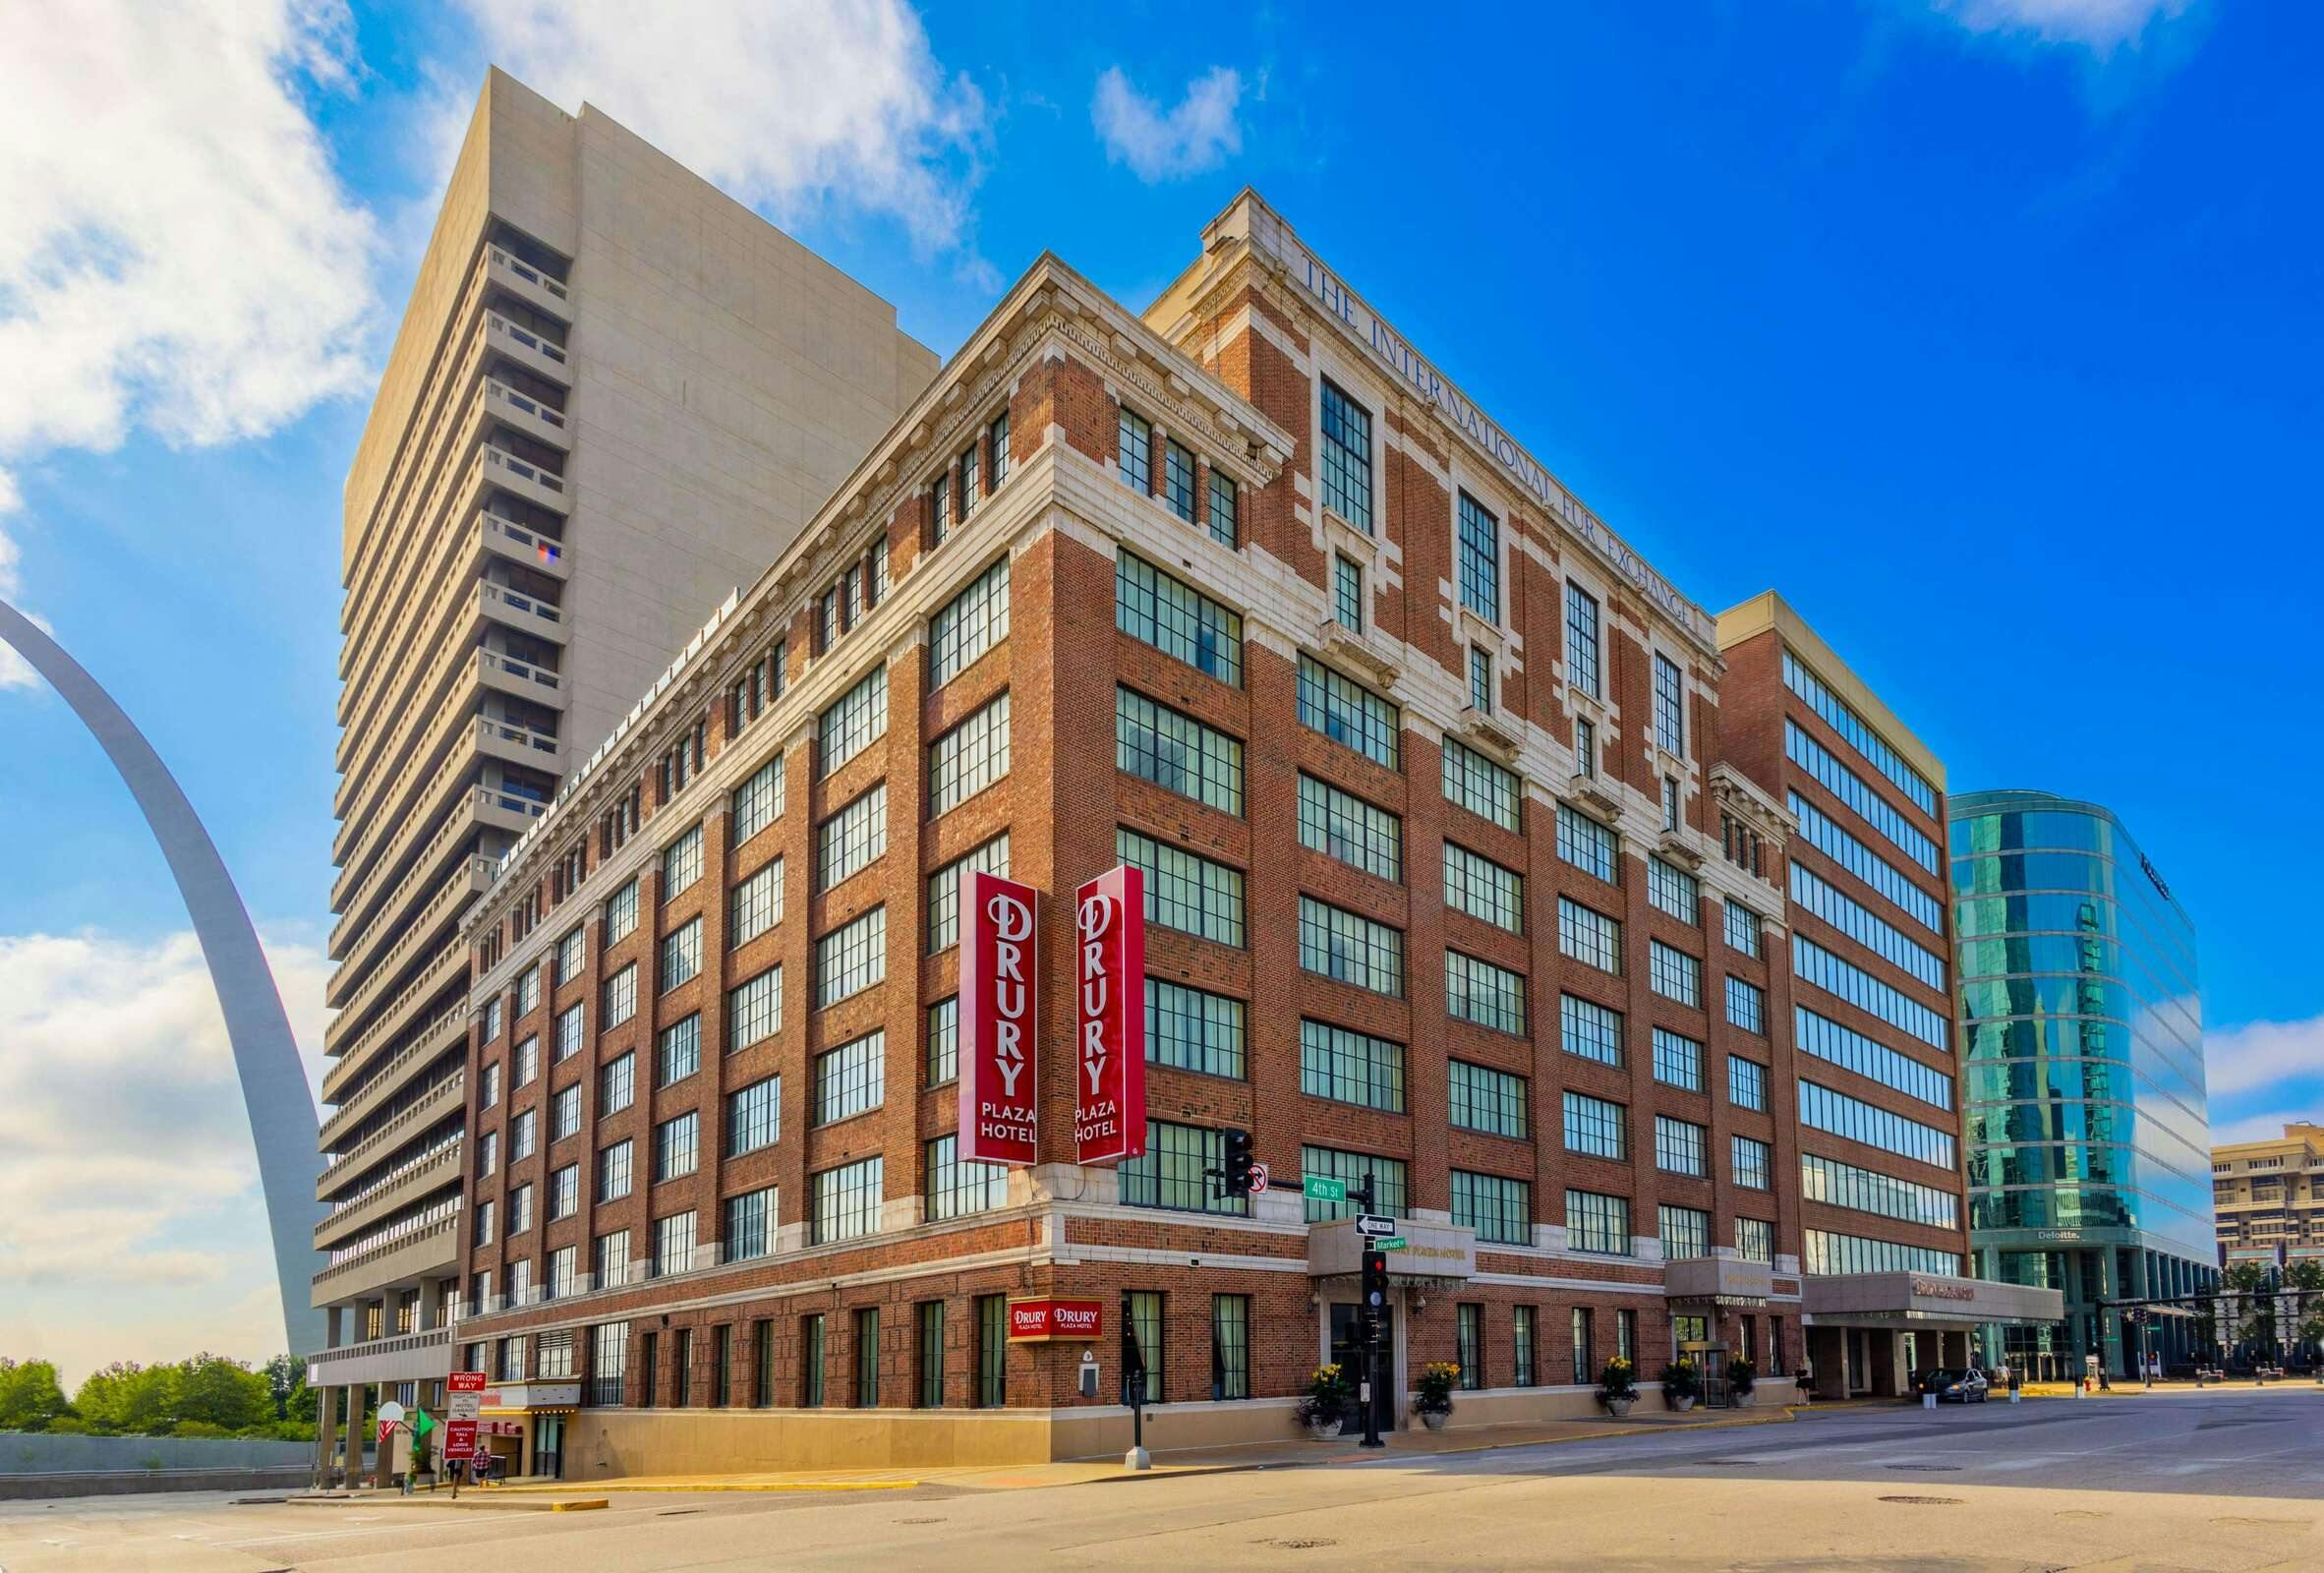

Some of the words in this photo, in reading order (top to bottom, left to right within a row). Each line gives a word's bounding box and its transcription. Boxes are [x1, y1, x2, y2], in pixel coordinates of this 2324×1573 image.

[1302, 254, 1358, 329] THE
[1372, 320, 1551, 502] INTERNATIONAL
[1562, 495, 1597, 543] FUR
[1607, 535, 1691, 626] EXCHANGE
[987, 894, 1032, 1096] DRURY
[1077, 895, 1112, 1095] DRURY
[981, 1101, 1036, 1124] PLAZA
[1075, 1100, 1116, 1123] PLAZA
[981, 1122, 1037, 1143] HOTEL
[1075, 1120, 1117, 1142] HOTEL
[1312, 1182, 1327, 1195] 4th
[1330, 1186, 1338, 1197] St
[1376, 1240, 1400, 1250] Market
[1015, 1310, 1047, 1324] DRURY
[1054, 1308, 1098, 1322] DRURY
